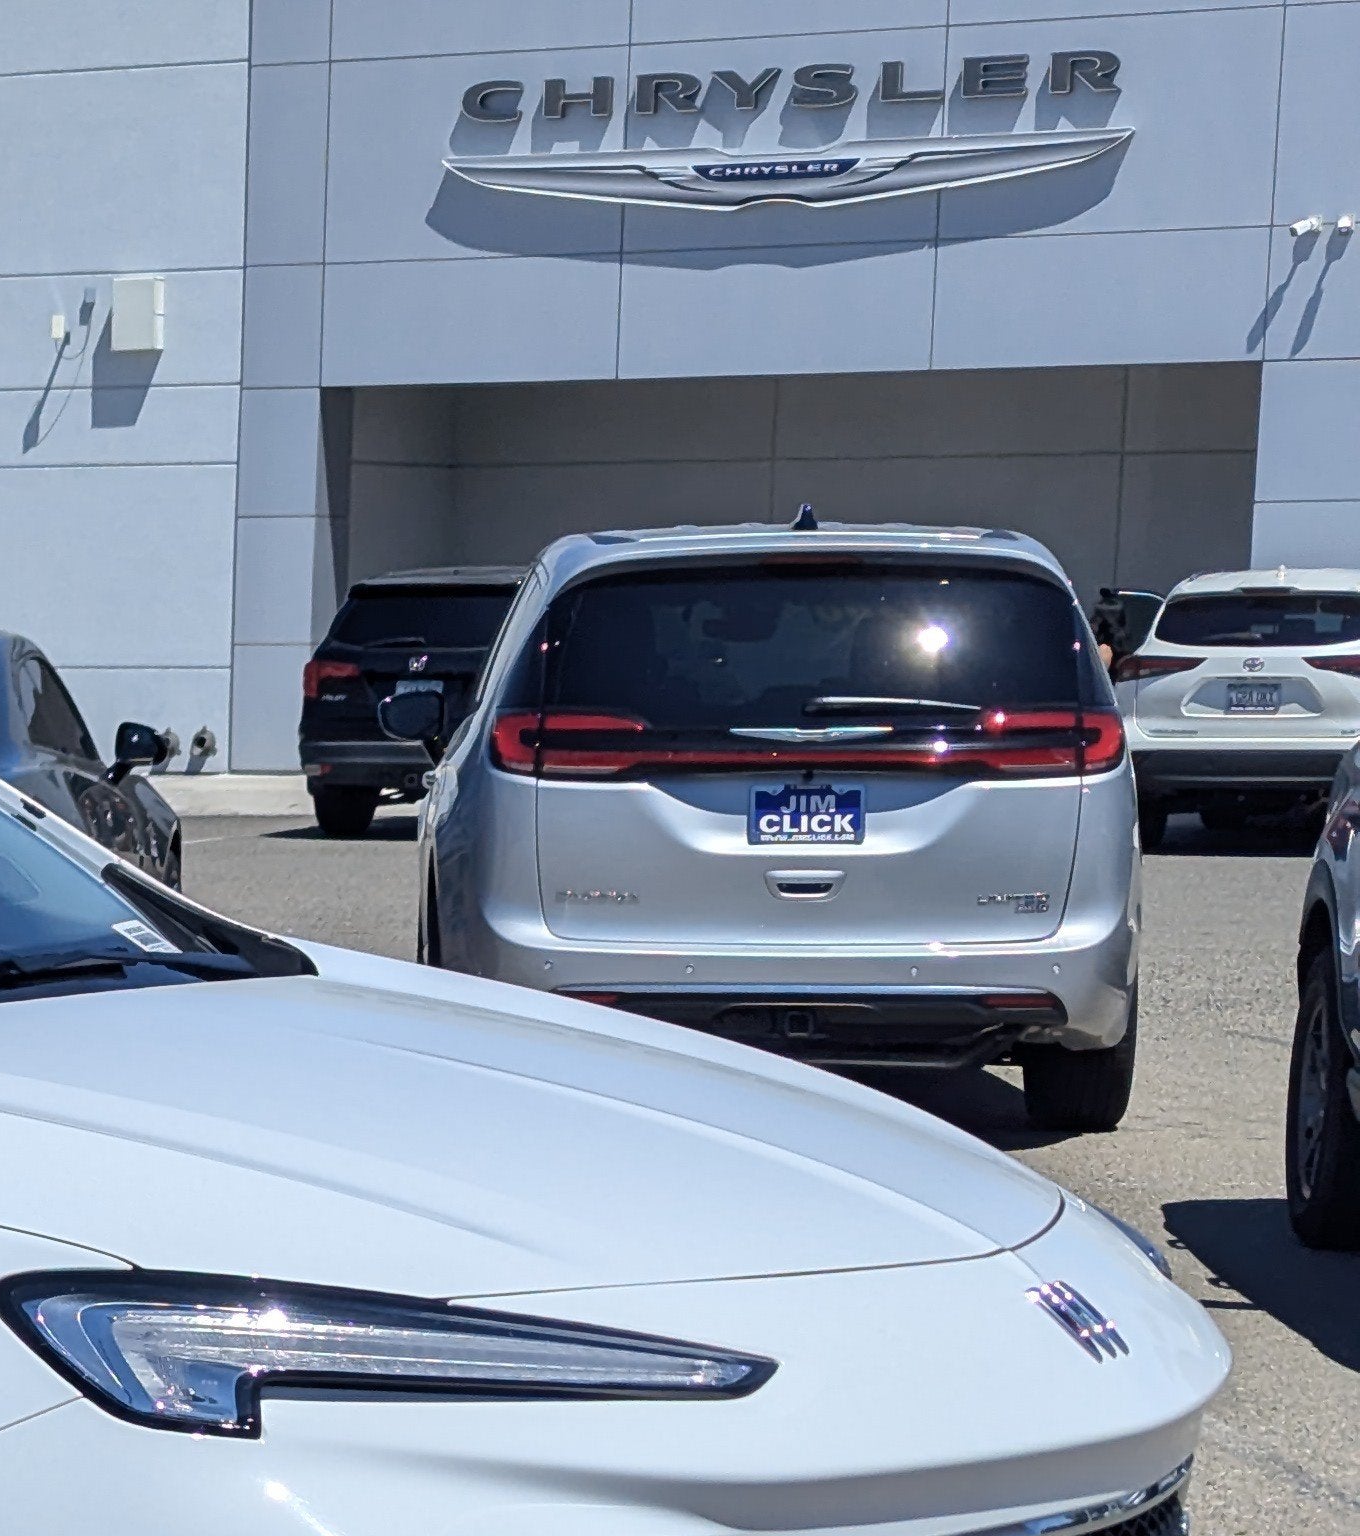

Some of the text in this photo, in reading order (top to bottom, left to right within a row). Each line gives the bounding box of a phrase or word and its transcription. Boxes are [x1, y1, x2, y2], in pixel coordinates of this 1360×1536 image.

[462, 50, 1122, 123] CHRYSLER
[708, 163, 840, 177] CHRYSLER
[780, 794, 836, 813] JIM
[759, 814, 855, 833] CLICK
